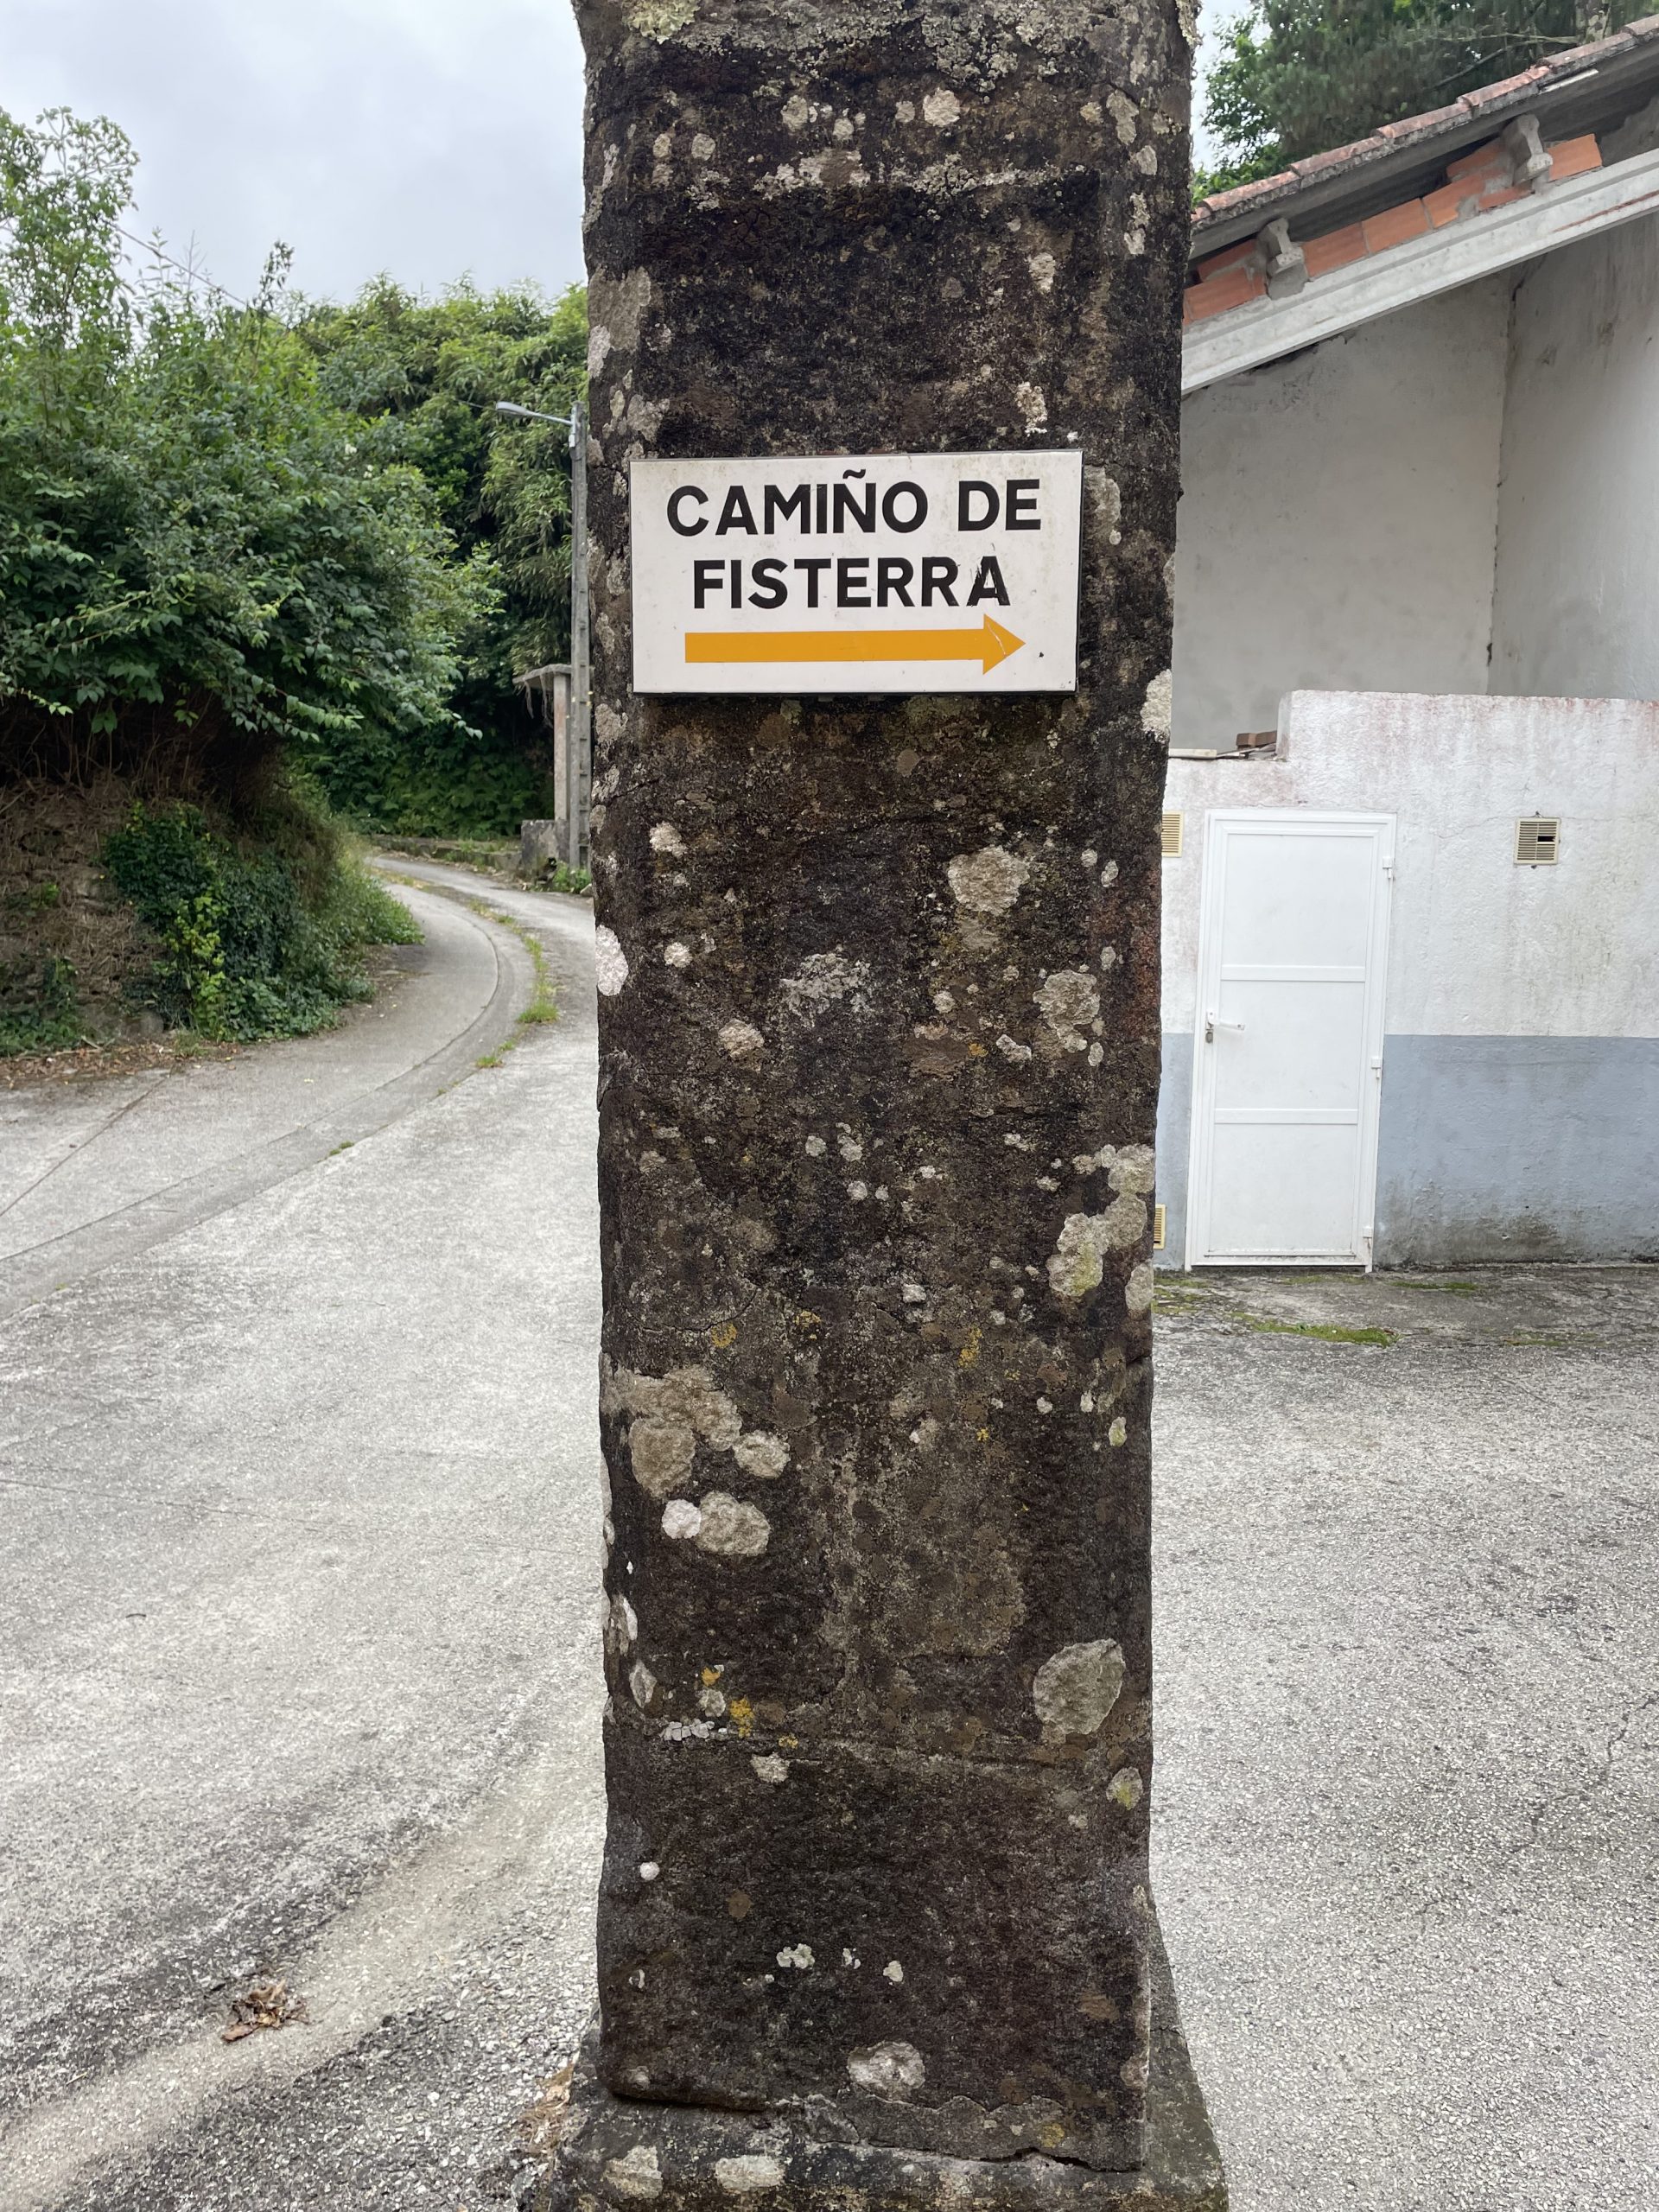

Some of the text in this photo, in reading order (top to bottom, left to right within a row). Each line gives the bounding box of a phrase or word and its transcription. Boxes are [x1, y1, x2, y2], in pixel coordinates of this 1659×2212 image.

[666, 468, 1041, 537] CAMIÑO DE
[693, 556, 1011, 610] FISTERRA
